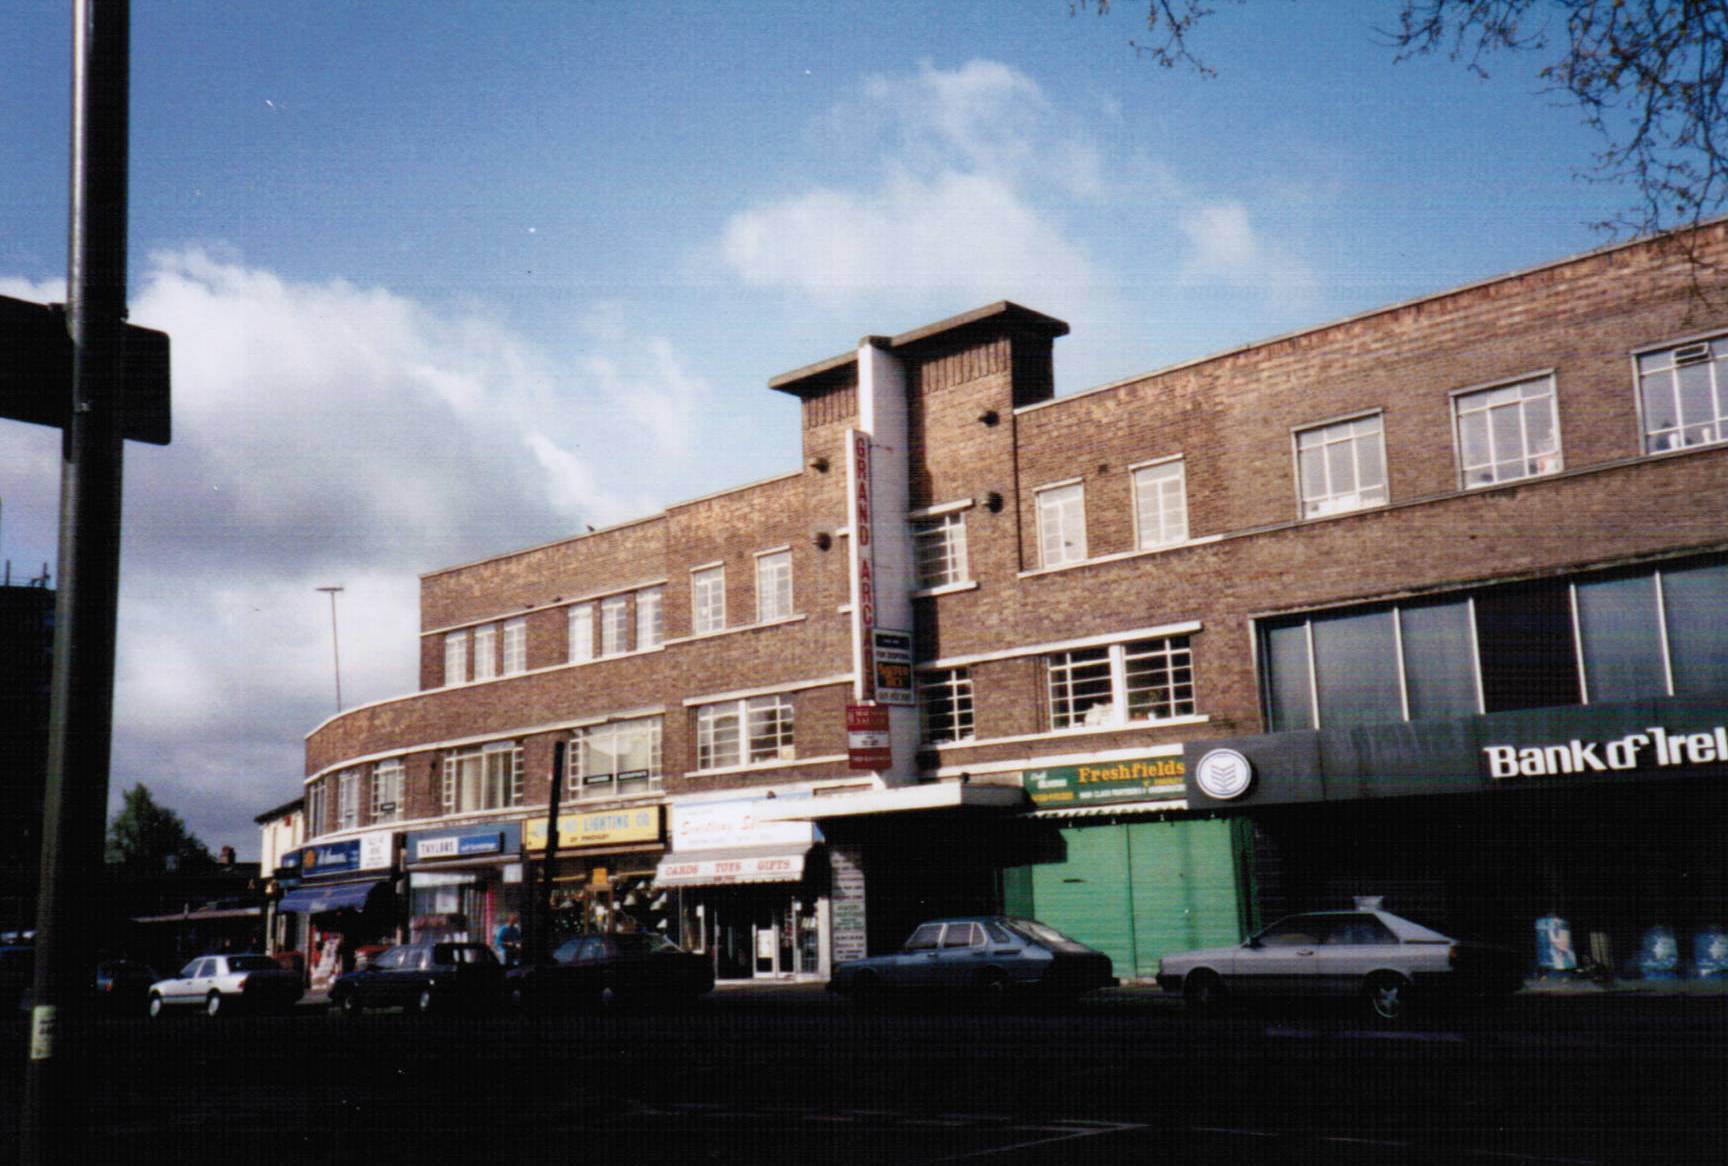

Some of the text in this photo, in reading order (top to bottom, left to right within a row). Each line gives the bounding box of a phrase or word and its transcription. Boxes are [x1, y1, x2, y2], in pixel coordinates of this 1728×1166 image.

[856, 438, 869, 545] GRAND
[1484, 739, 1607, 778] Bank
[1606, 734, 1649, 770] of
[1077, 760, 1185, 784] Freshfields
[583, 814, 629, 832] LIGHTING
[421, 841, 455, 854] TAYLORS
[666, 859, 791, 876] CARDS TOYS GIFTS
